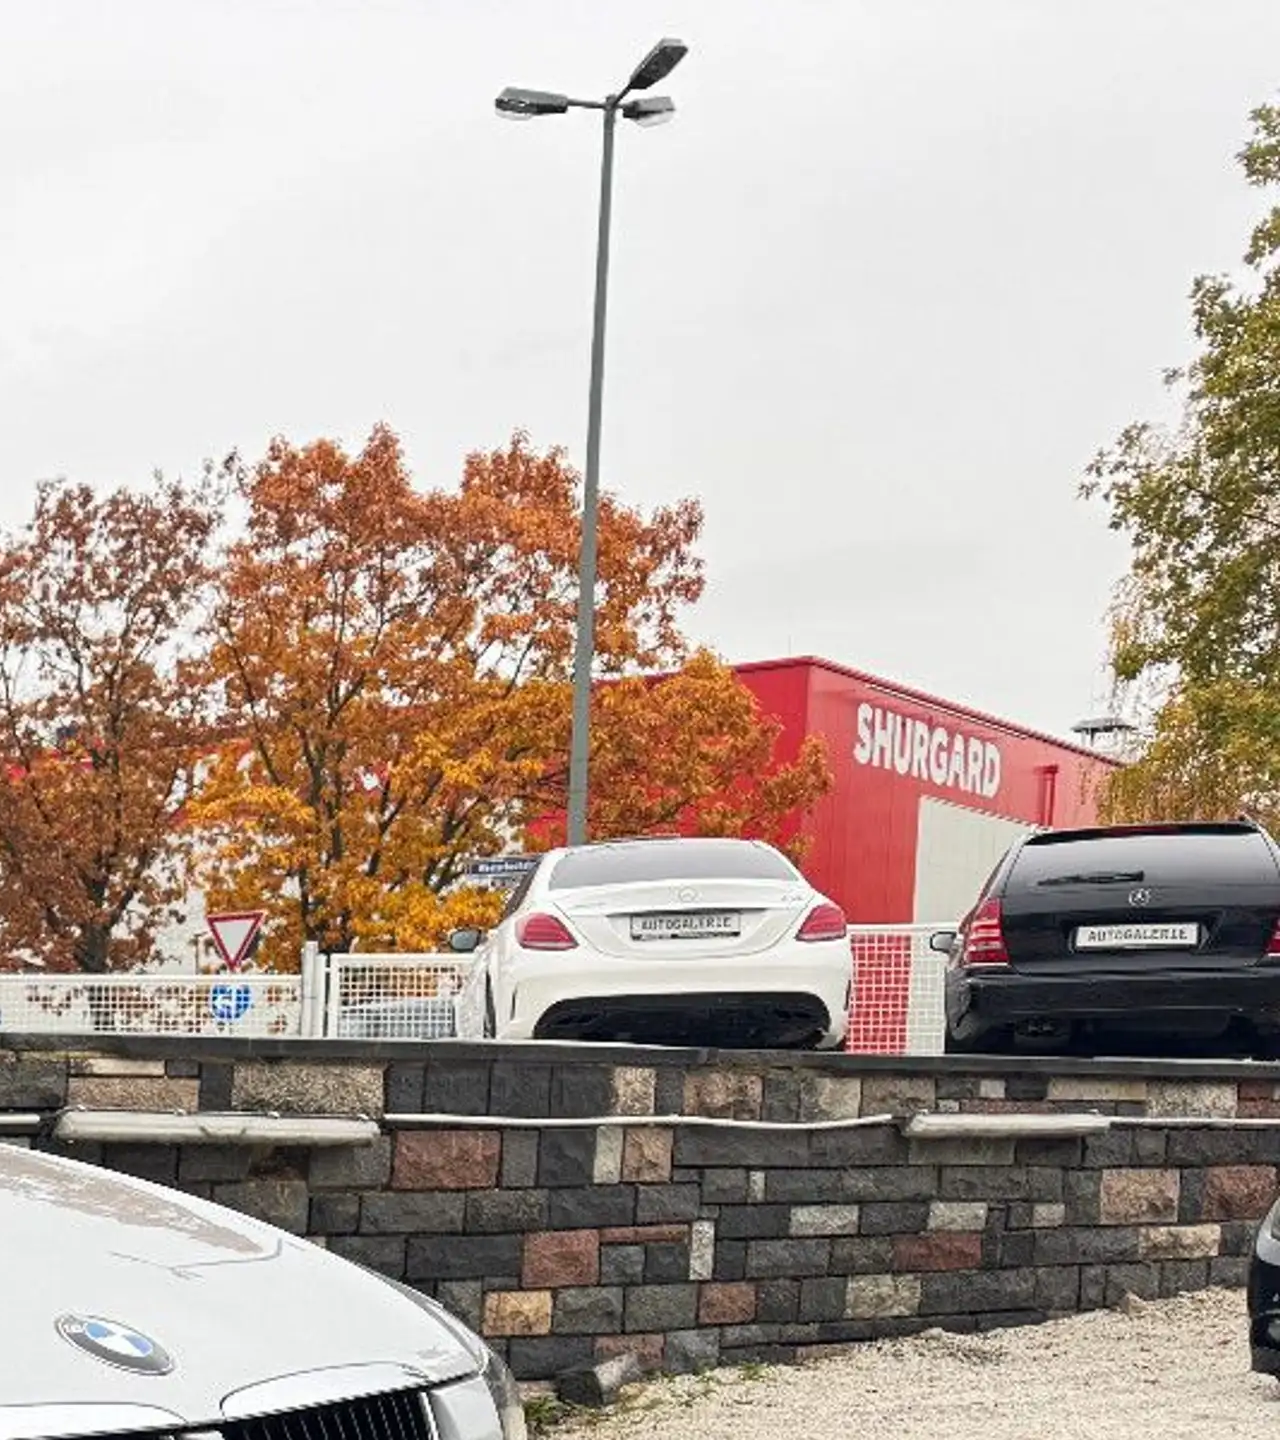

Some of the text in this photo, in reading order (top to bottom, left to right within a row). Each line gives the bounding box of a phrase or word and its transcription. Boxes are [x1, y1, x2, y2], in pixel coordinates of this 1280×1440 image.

[853, 702, 1001, 799] SHURGARD
[642, 916, 731, 931] AUTOGALERIE
[1087, 928, 1188, 942] AUTOGALERIE
